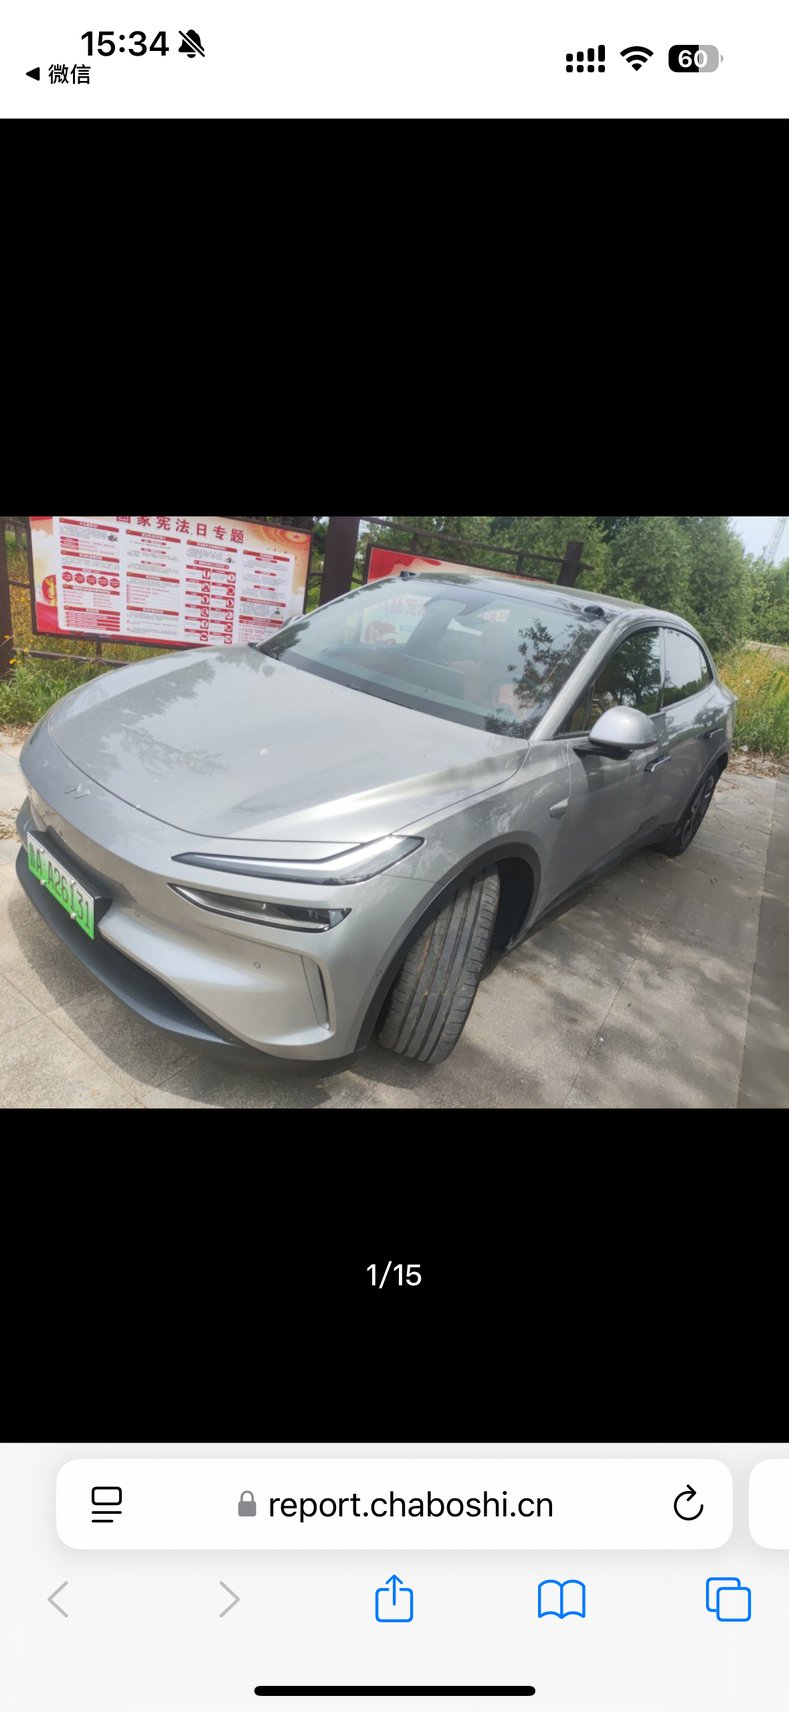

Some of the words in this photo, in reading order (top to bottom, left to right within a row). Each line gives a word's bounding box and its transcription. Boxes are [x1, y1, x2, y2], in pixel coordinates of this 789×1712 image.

[81, 30, 170, 57] 15:34
[678, 49, 708, 68] 60
[48, 63, 92, 85] 微信
[366, 1260, 422, 1289] 1/15
[269, 1490, 554, 1523] report.chaboshi.cn
